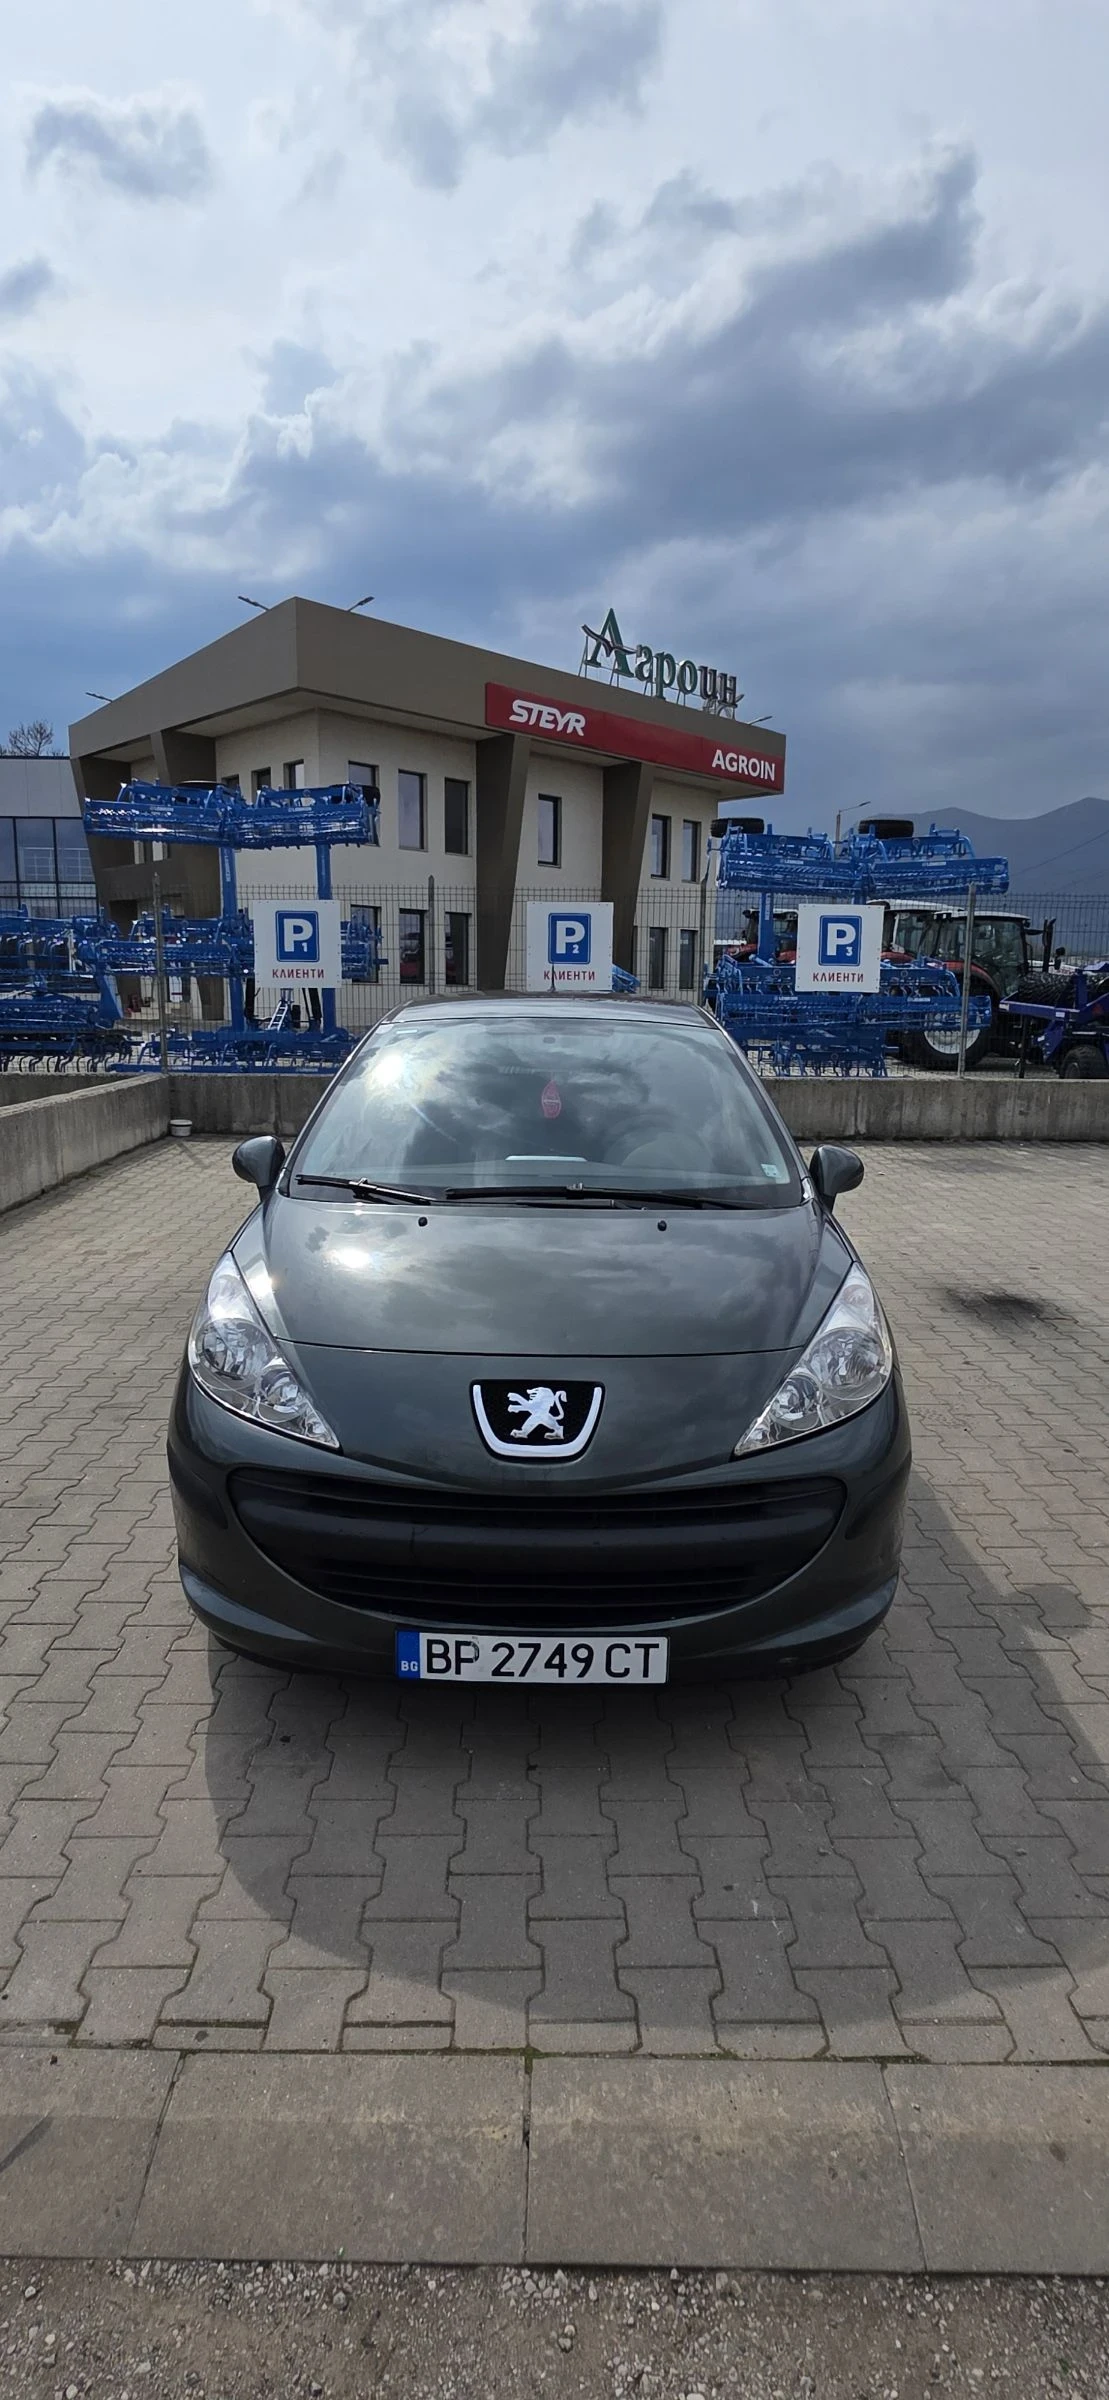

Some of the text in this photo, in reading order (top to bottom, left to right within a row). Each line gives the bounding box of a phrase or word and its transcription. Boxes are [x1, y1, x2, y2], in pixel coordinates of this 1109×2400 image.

[509, 699, 586, 736] STEYR
[711, 749, 776, 782] AGROIN
[272, 968, 325, 979] КЛИЕНТИ
[812, 972, 864, 983] КЛИЕНТИ
[400, 1660, 419, 1672] BG
[426, 1638, 660, 1678] BP 2749 CT
